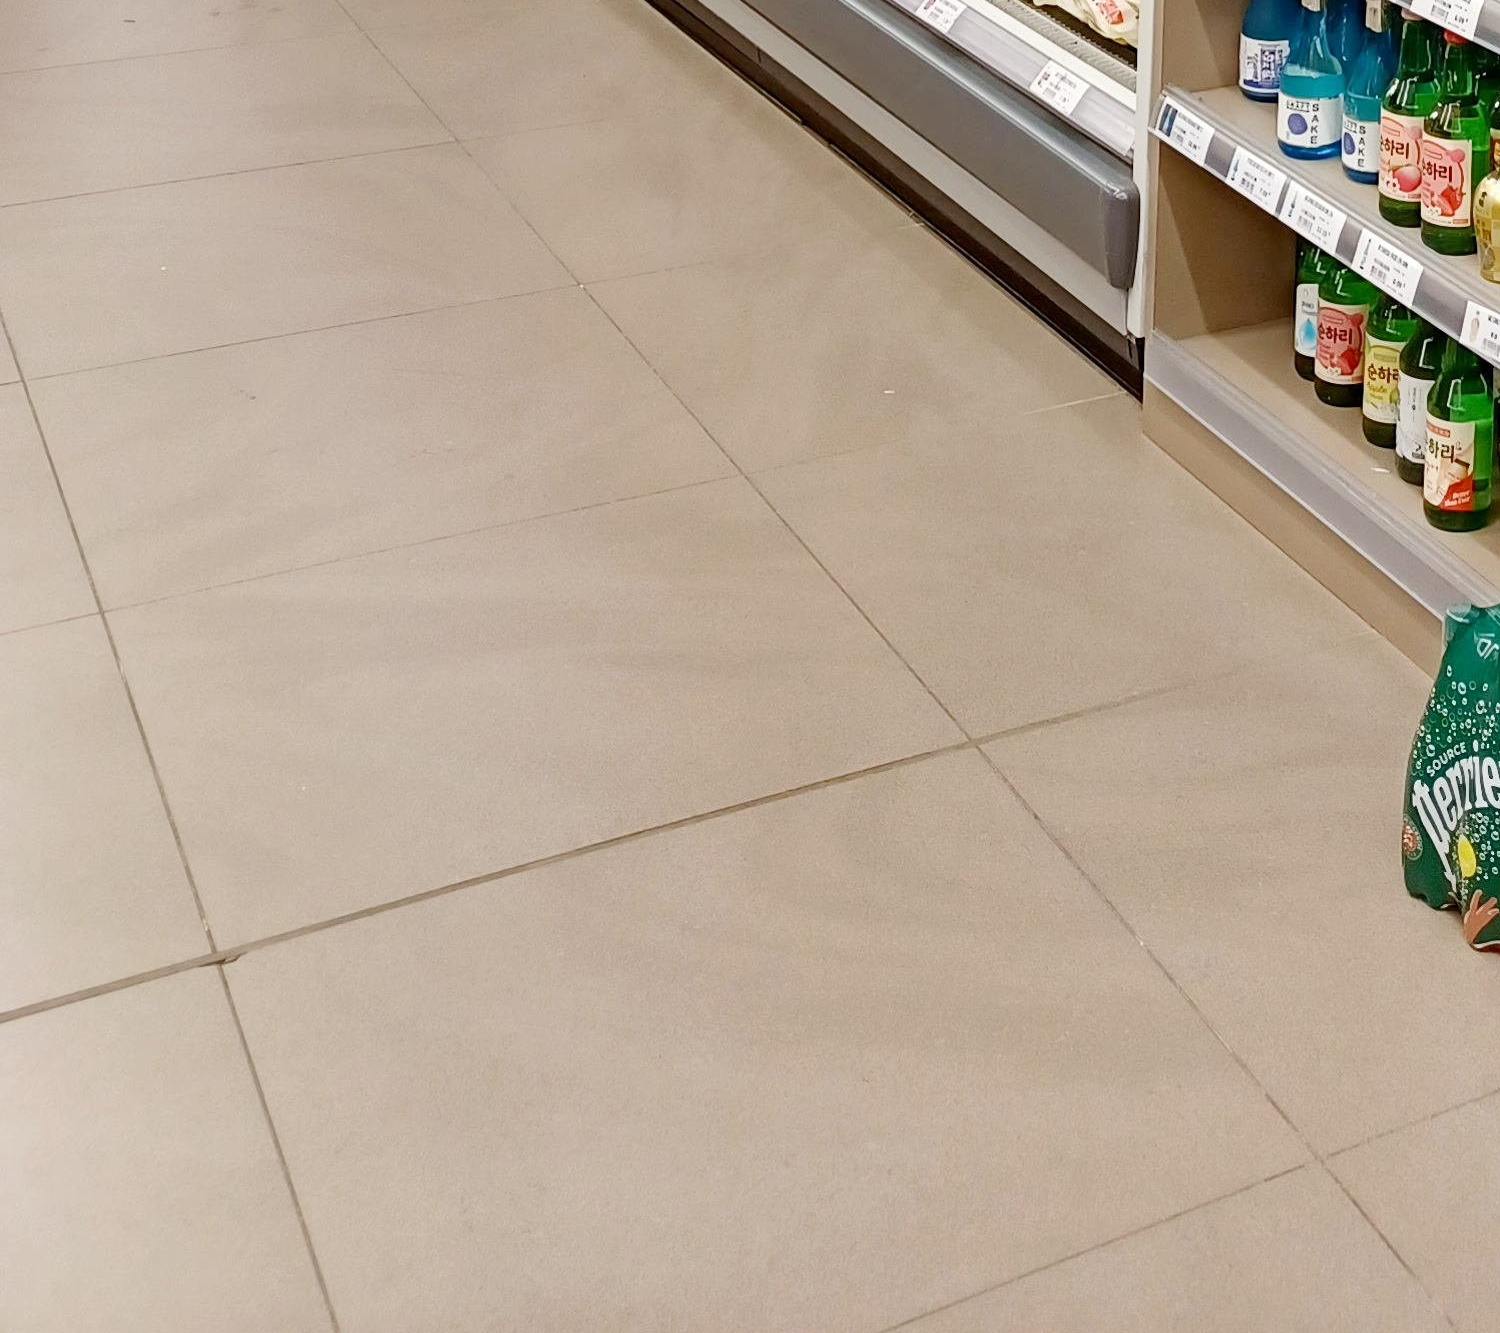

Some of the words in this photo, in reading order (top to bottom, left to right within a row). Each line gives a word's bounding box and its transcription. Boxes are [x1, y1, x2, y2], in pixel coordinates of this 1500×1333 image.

[1310, 103, 1319, 145] SAKE
[1357, 126, 1366, 168] SAKE
[1318, 327, 1353, 345] 순하리
[1426, 741, 1467, 777] SOURCE
